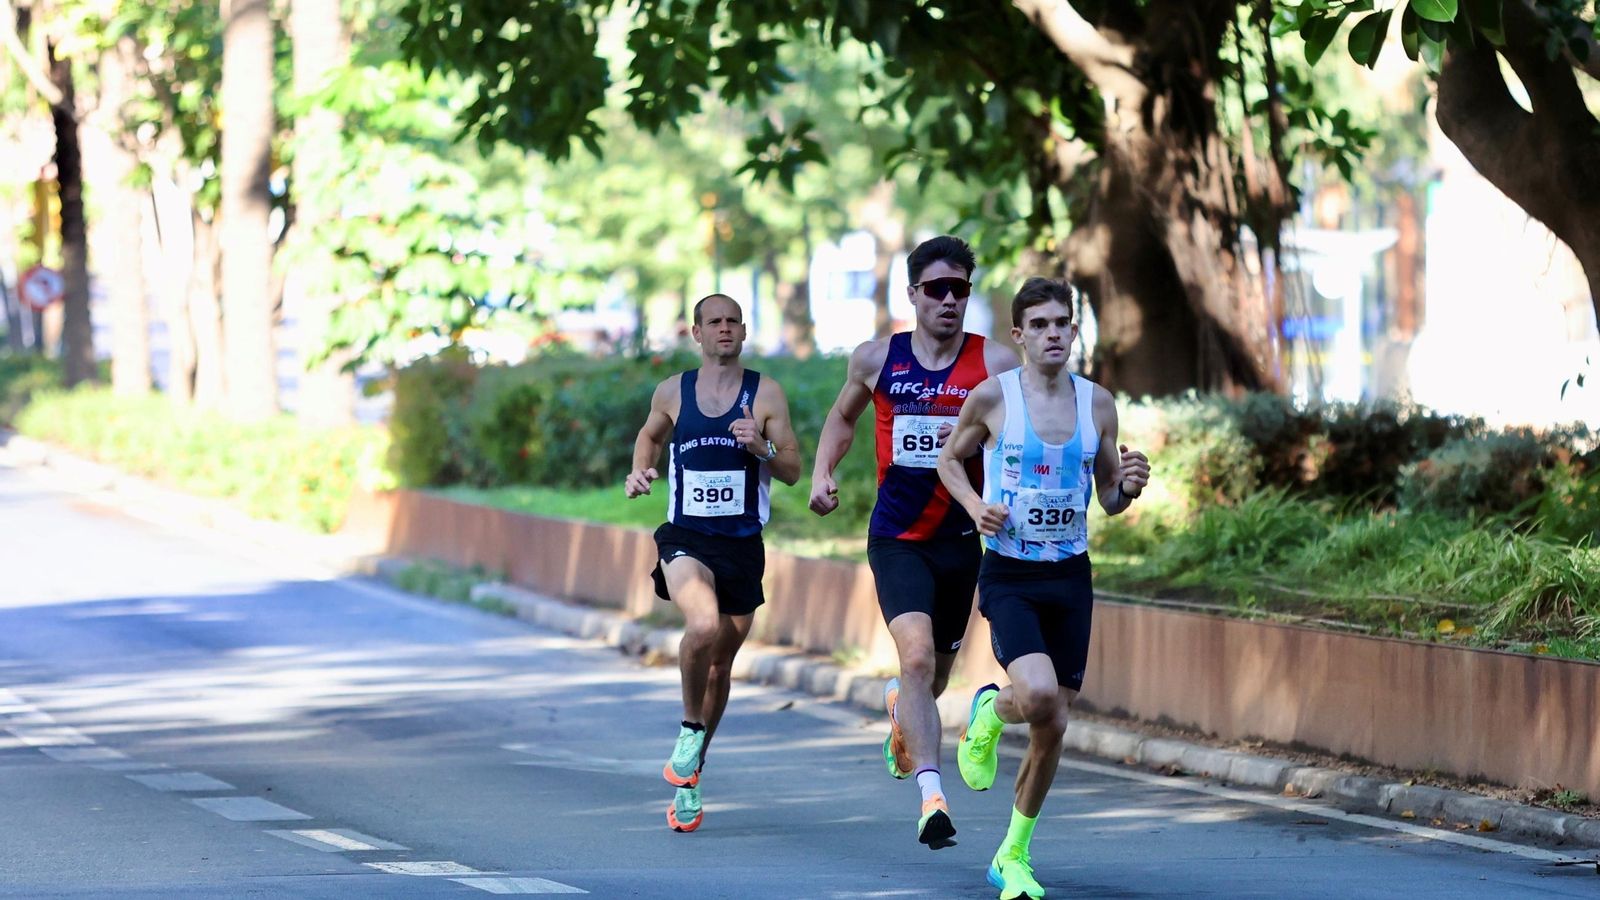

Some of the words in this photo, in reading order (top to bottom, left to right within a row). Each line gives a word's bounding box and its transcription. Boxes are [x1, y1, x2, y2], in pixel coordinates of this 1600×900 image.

[891, 369, 910, 377] SPORT
[889, 382, 923, 395] RFC
[936, 382, 970, 399] Lièg
[700, 436, 735, 447] EATON
[693, 487, 734, 503] 390
[1028, 508, 1075, 526] 330
